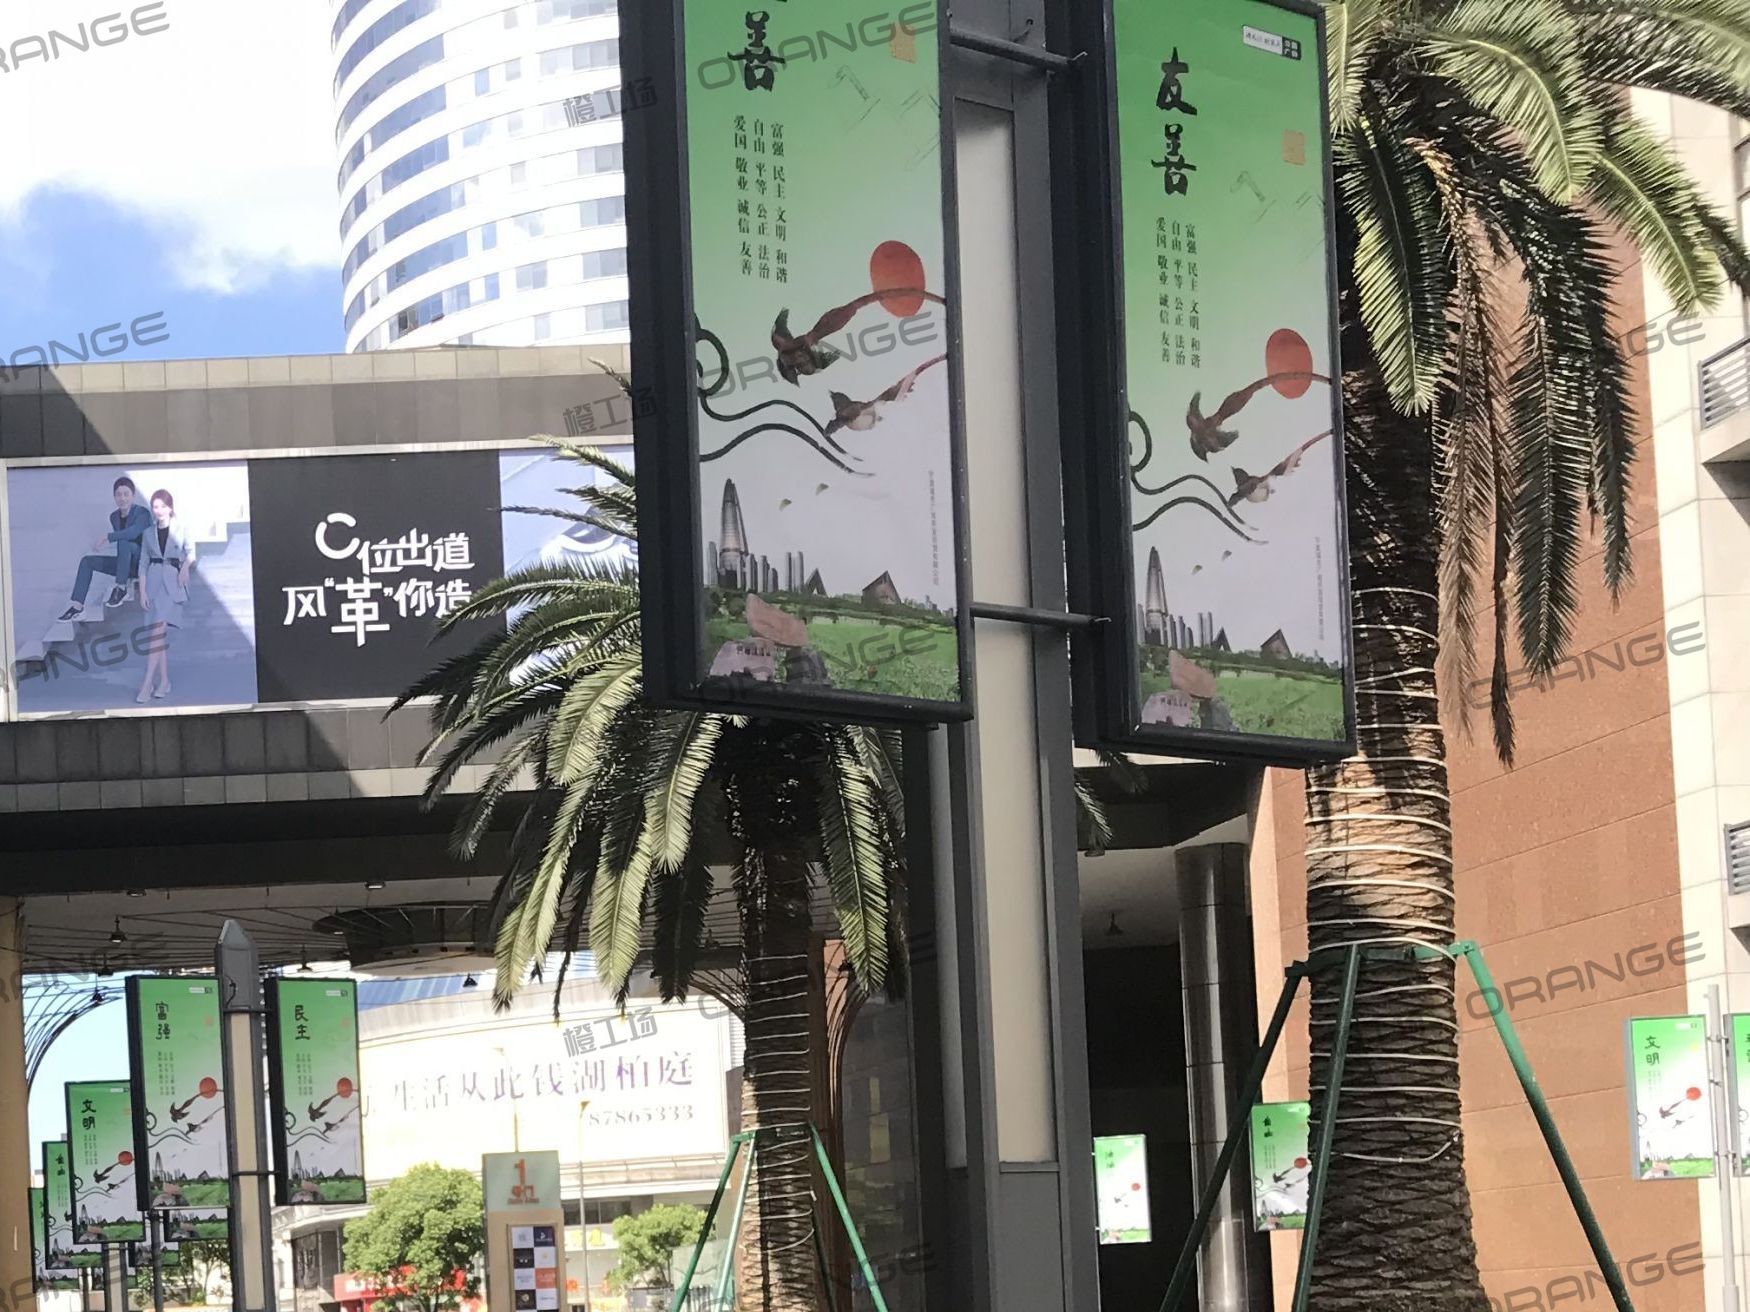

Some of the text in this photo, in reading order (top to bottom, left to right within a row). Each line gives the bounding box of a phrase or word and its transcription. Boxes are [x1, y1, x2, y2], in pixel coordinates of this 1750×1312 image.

[734, 115, 752, 275] 爱国 敬业 诚信 友善
[754, 119, 770, 279] 自由 平等 公正 法治
[771, 122, 787, 283] 富强 民主 文明 和谐
[1156, 217, 1170, 362] 爱国 敬业 诚信 友善
[1172, 220, 1185, 365] 自由 平等 公正 法治
[1186, 224, 1200, 368] 富强 民主 文明 和谐
[315, 512, 475, 575] C位出道
[294, 1004, 310, 1040] 民主
[1644, 1035, 1661, 1067] 文明
[81, 1099, 97, 1130] 文明
